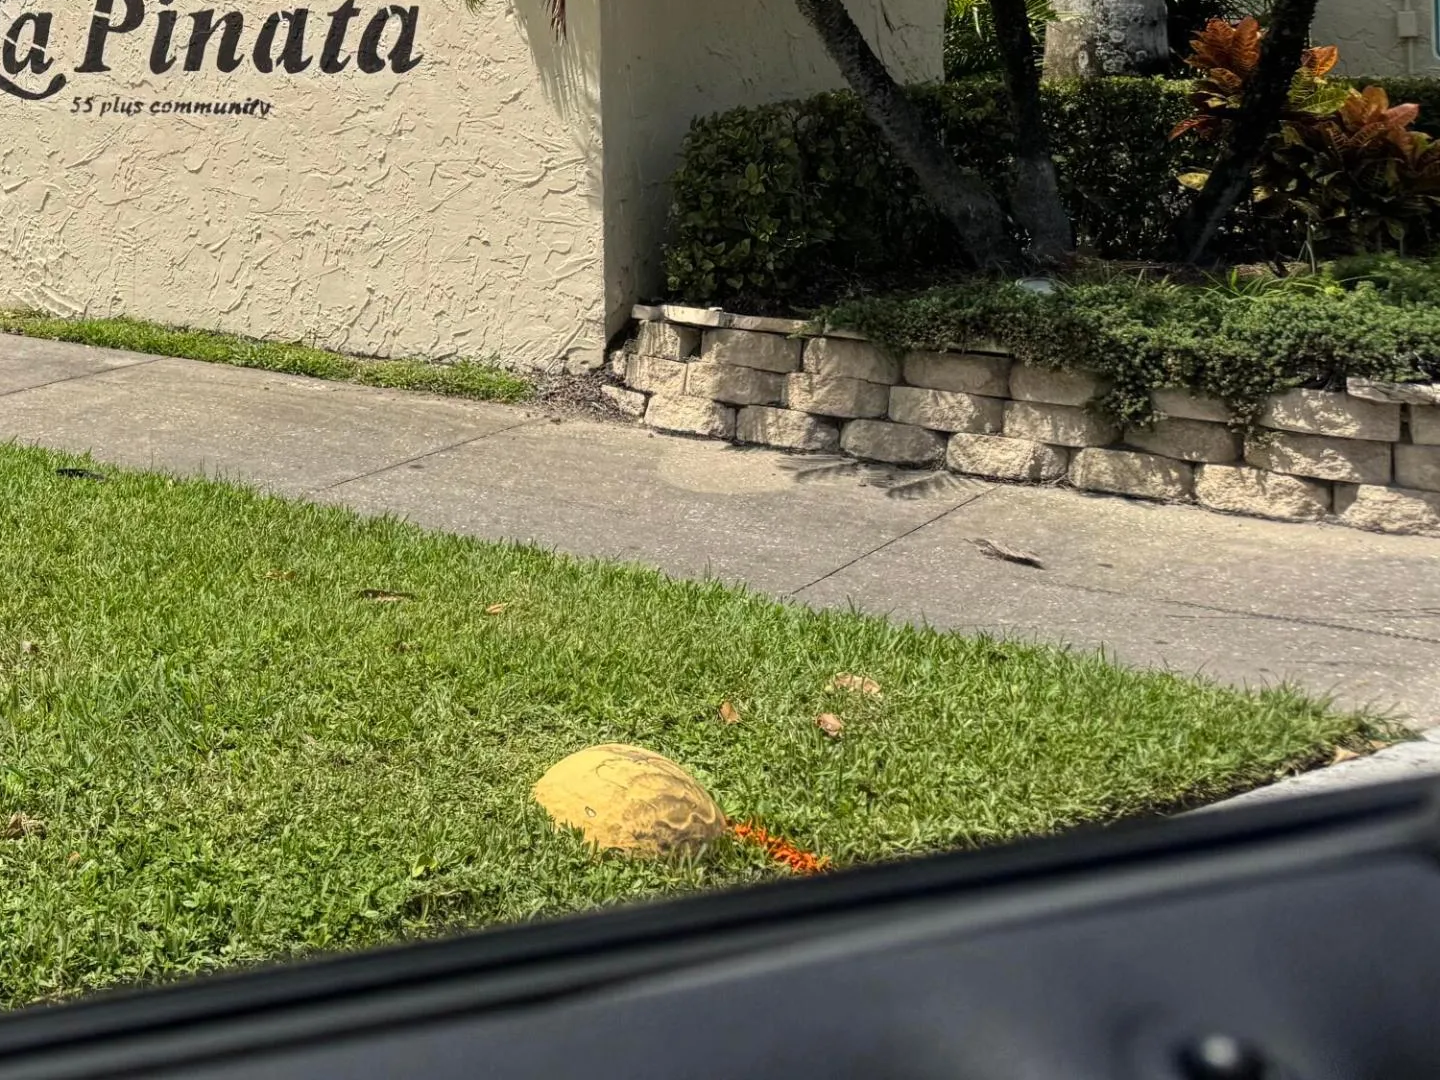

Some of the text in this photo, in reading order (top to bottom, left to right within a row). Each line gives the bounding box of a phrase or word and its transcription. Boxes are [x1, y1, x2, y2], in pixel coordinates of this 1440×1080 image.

[70, 96, 272, 118] 55 plus community
